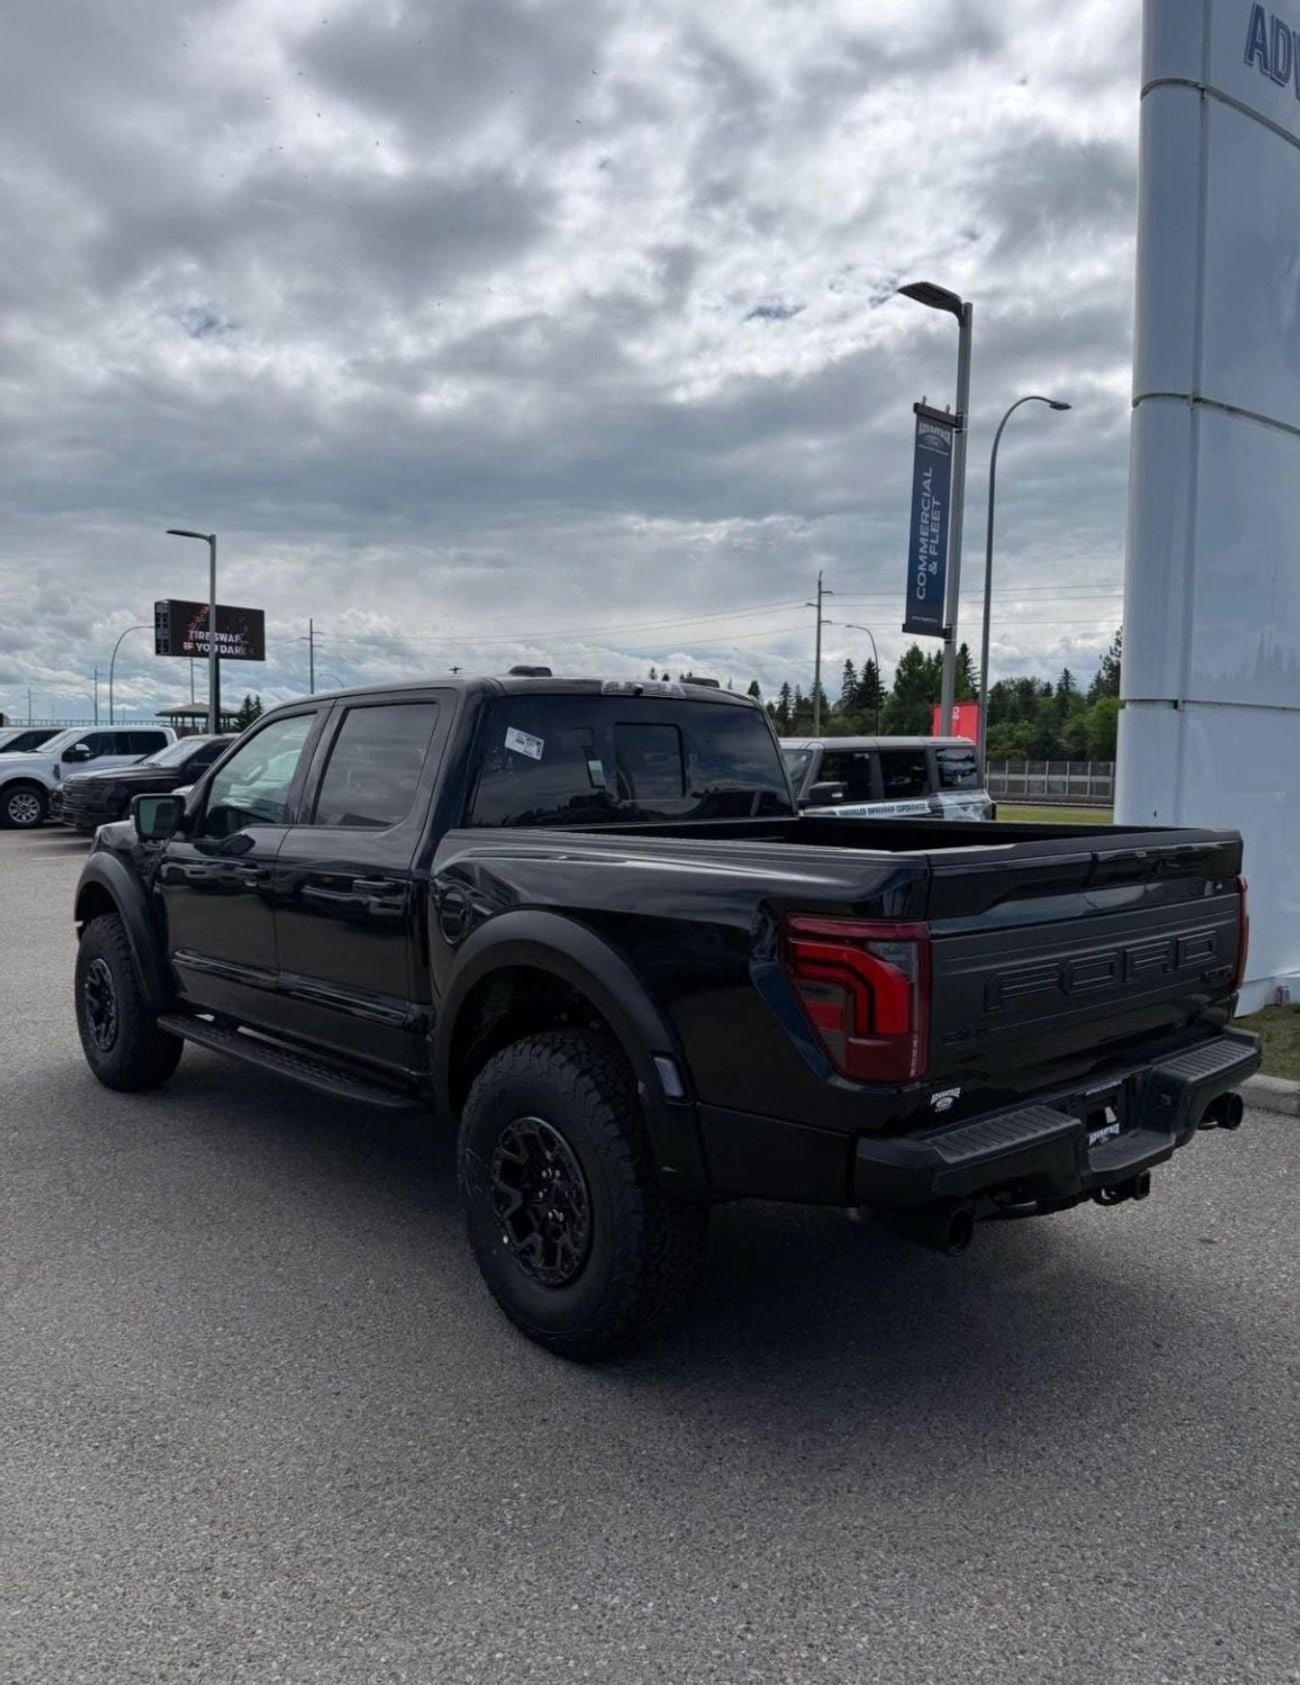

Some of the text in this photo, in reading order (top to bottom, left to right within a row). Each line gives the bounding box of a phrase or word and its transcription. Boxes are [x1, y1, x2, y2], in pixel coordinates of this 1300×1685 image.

[916, 467, 932, 600] COMMERCIAL
[928, 496, 941, 575] & FLEET
[183, 641, 194, 651] IF
[189, 630, 210, 641] TIRE
[984, 930, 1217, 1013] FORD
